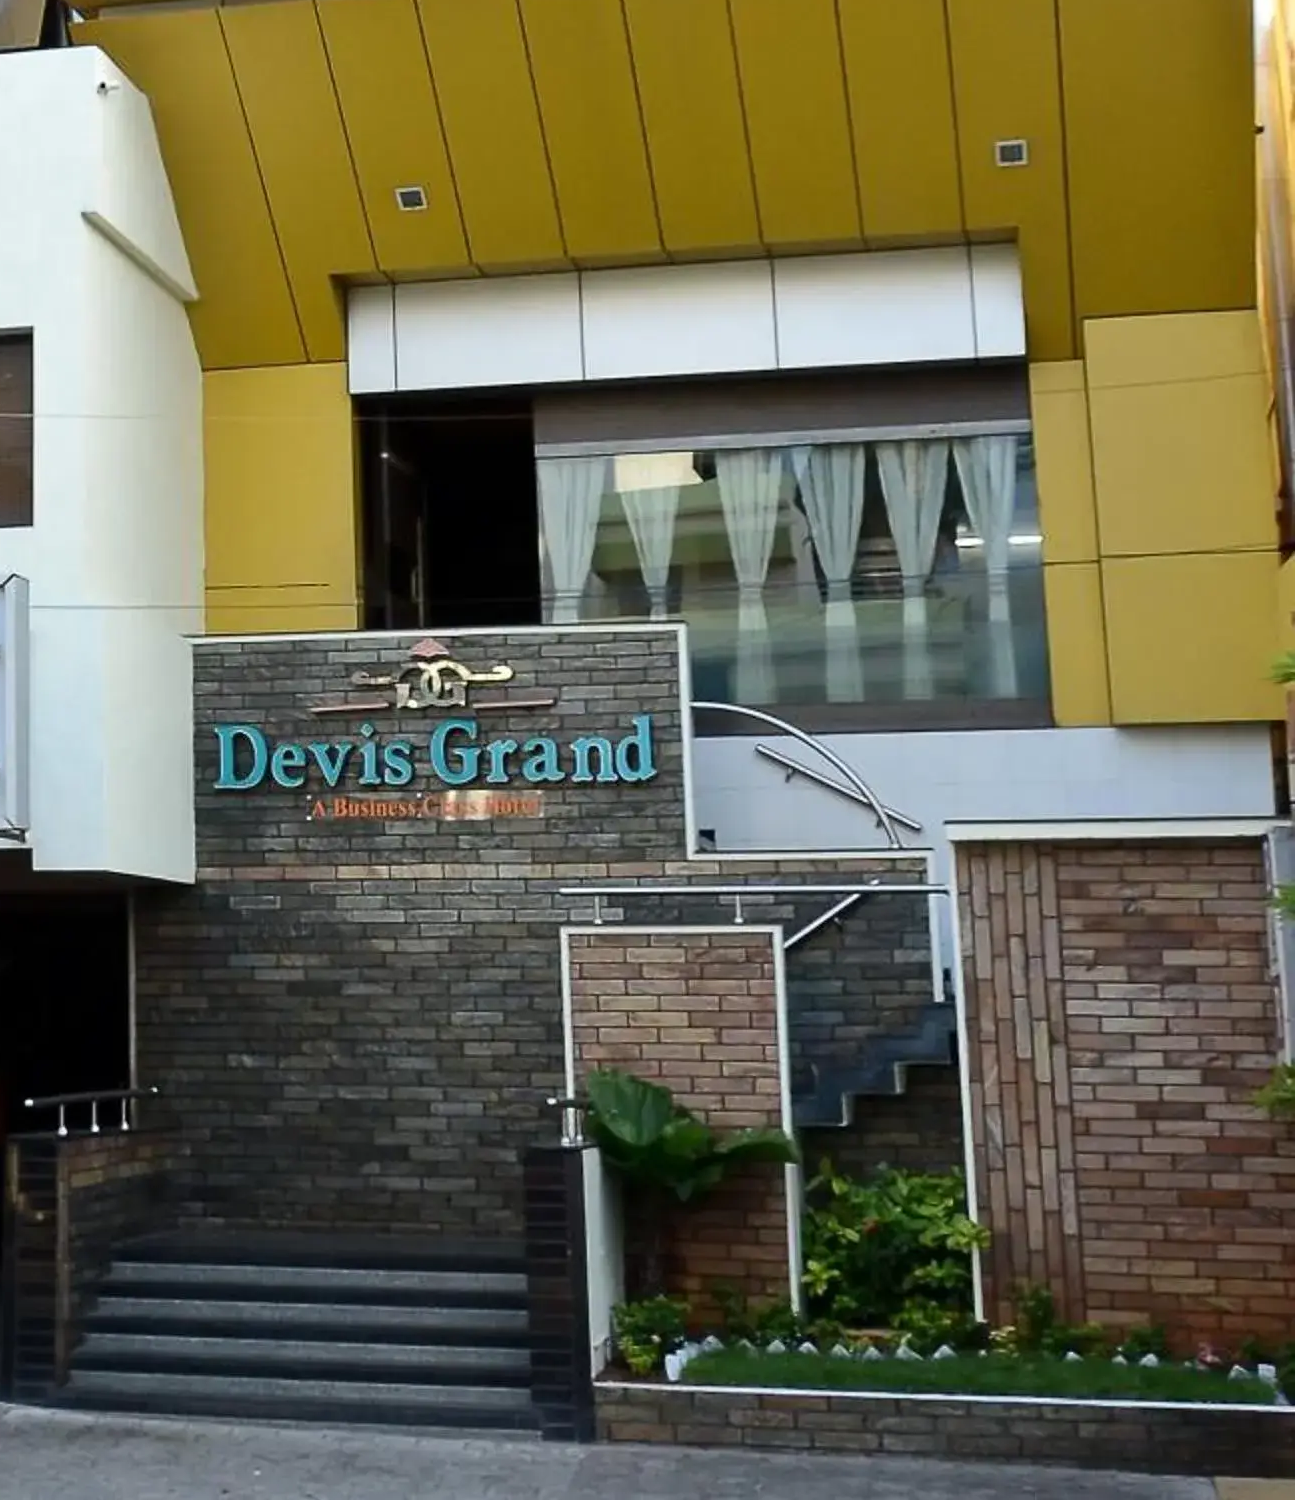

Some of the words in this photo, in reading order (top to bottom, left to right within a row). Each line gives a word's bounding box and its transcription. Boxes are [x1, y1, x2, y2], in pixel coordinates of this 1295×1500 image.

[212, 721, 415, 790] Devis
[429, 714, 658, 787] Grand
[333, 795, 418, 819] Business
